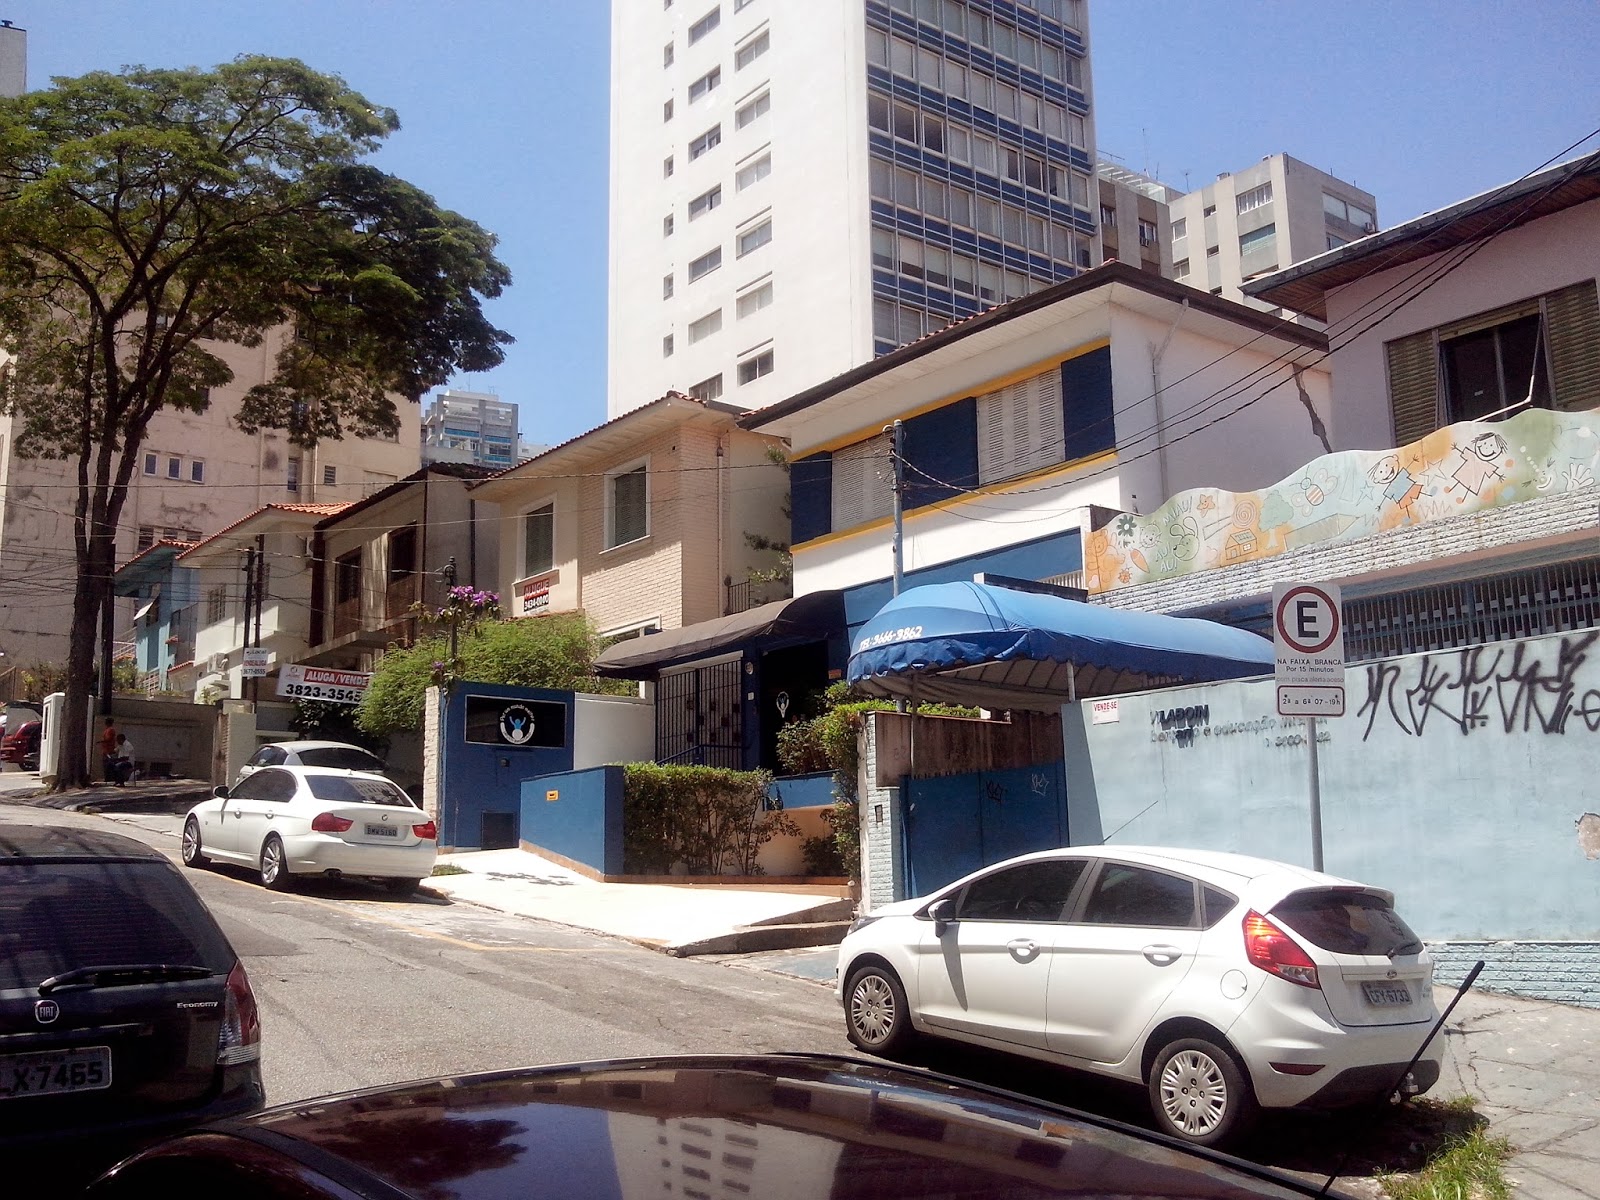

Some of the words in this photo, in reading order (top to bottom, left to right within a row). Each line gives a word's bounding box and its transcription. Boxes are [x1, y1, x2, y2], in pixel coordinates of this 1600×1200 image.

[1296, 600, 1320, 638] E
[1093, 701, 1118, 712] VENDE-SE
[176, 1001, 219, 1009] Economy
[39, 1006, 54, 1018] FIAT
